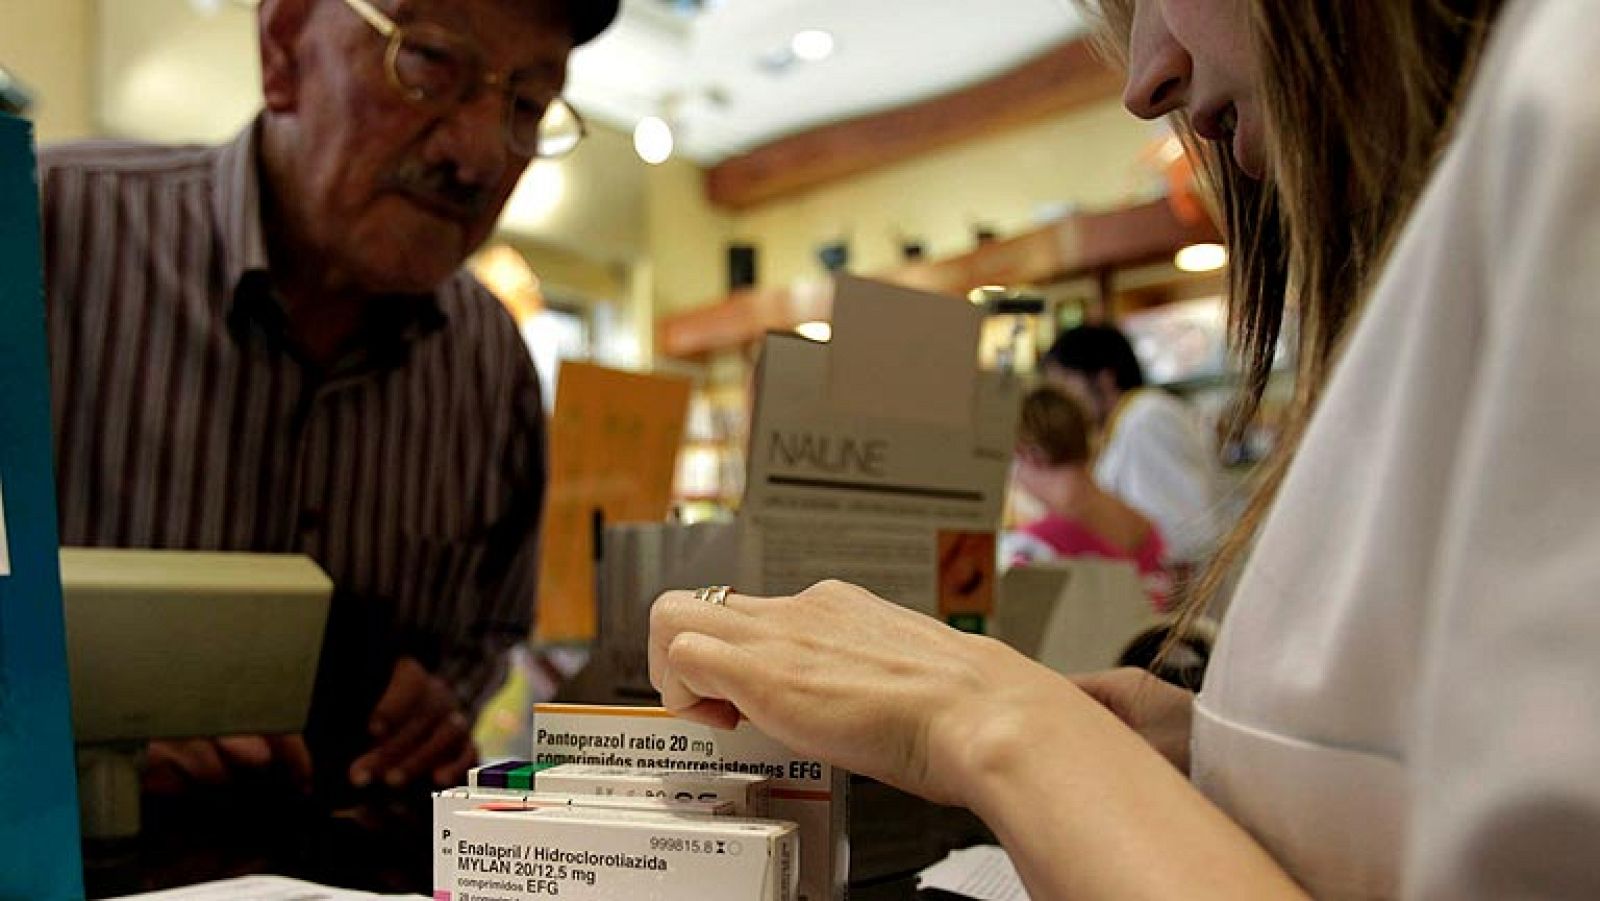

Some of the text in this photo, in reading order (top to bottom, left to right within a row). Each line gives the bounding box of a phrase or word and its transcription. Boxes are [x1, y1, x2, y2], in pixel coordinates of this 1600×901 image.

[537, 729, 714, 757] Pantoprazol ratio 20 mg
[788, 760, 822, 781] EFG
[457, 840, 523, 860] Enalapril
[533, 846, 668, 871] Hidroclorotiazida
[649, 836, 714, 854] 999815.8
[457, 857, 512, 875] MYLAN
[571, 868, 596, 885] mg
[457, 877, 559, 896] comprimidos EFG
